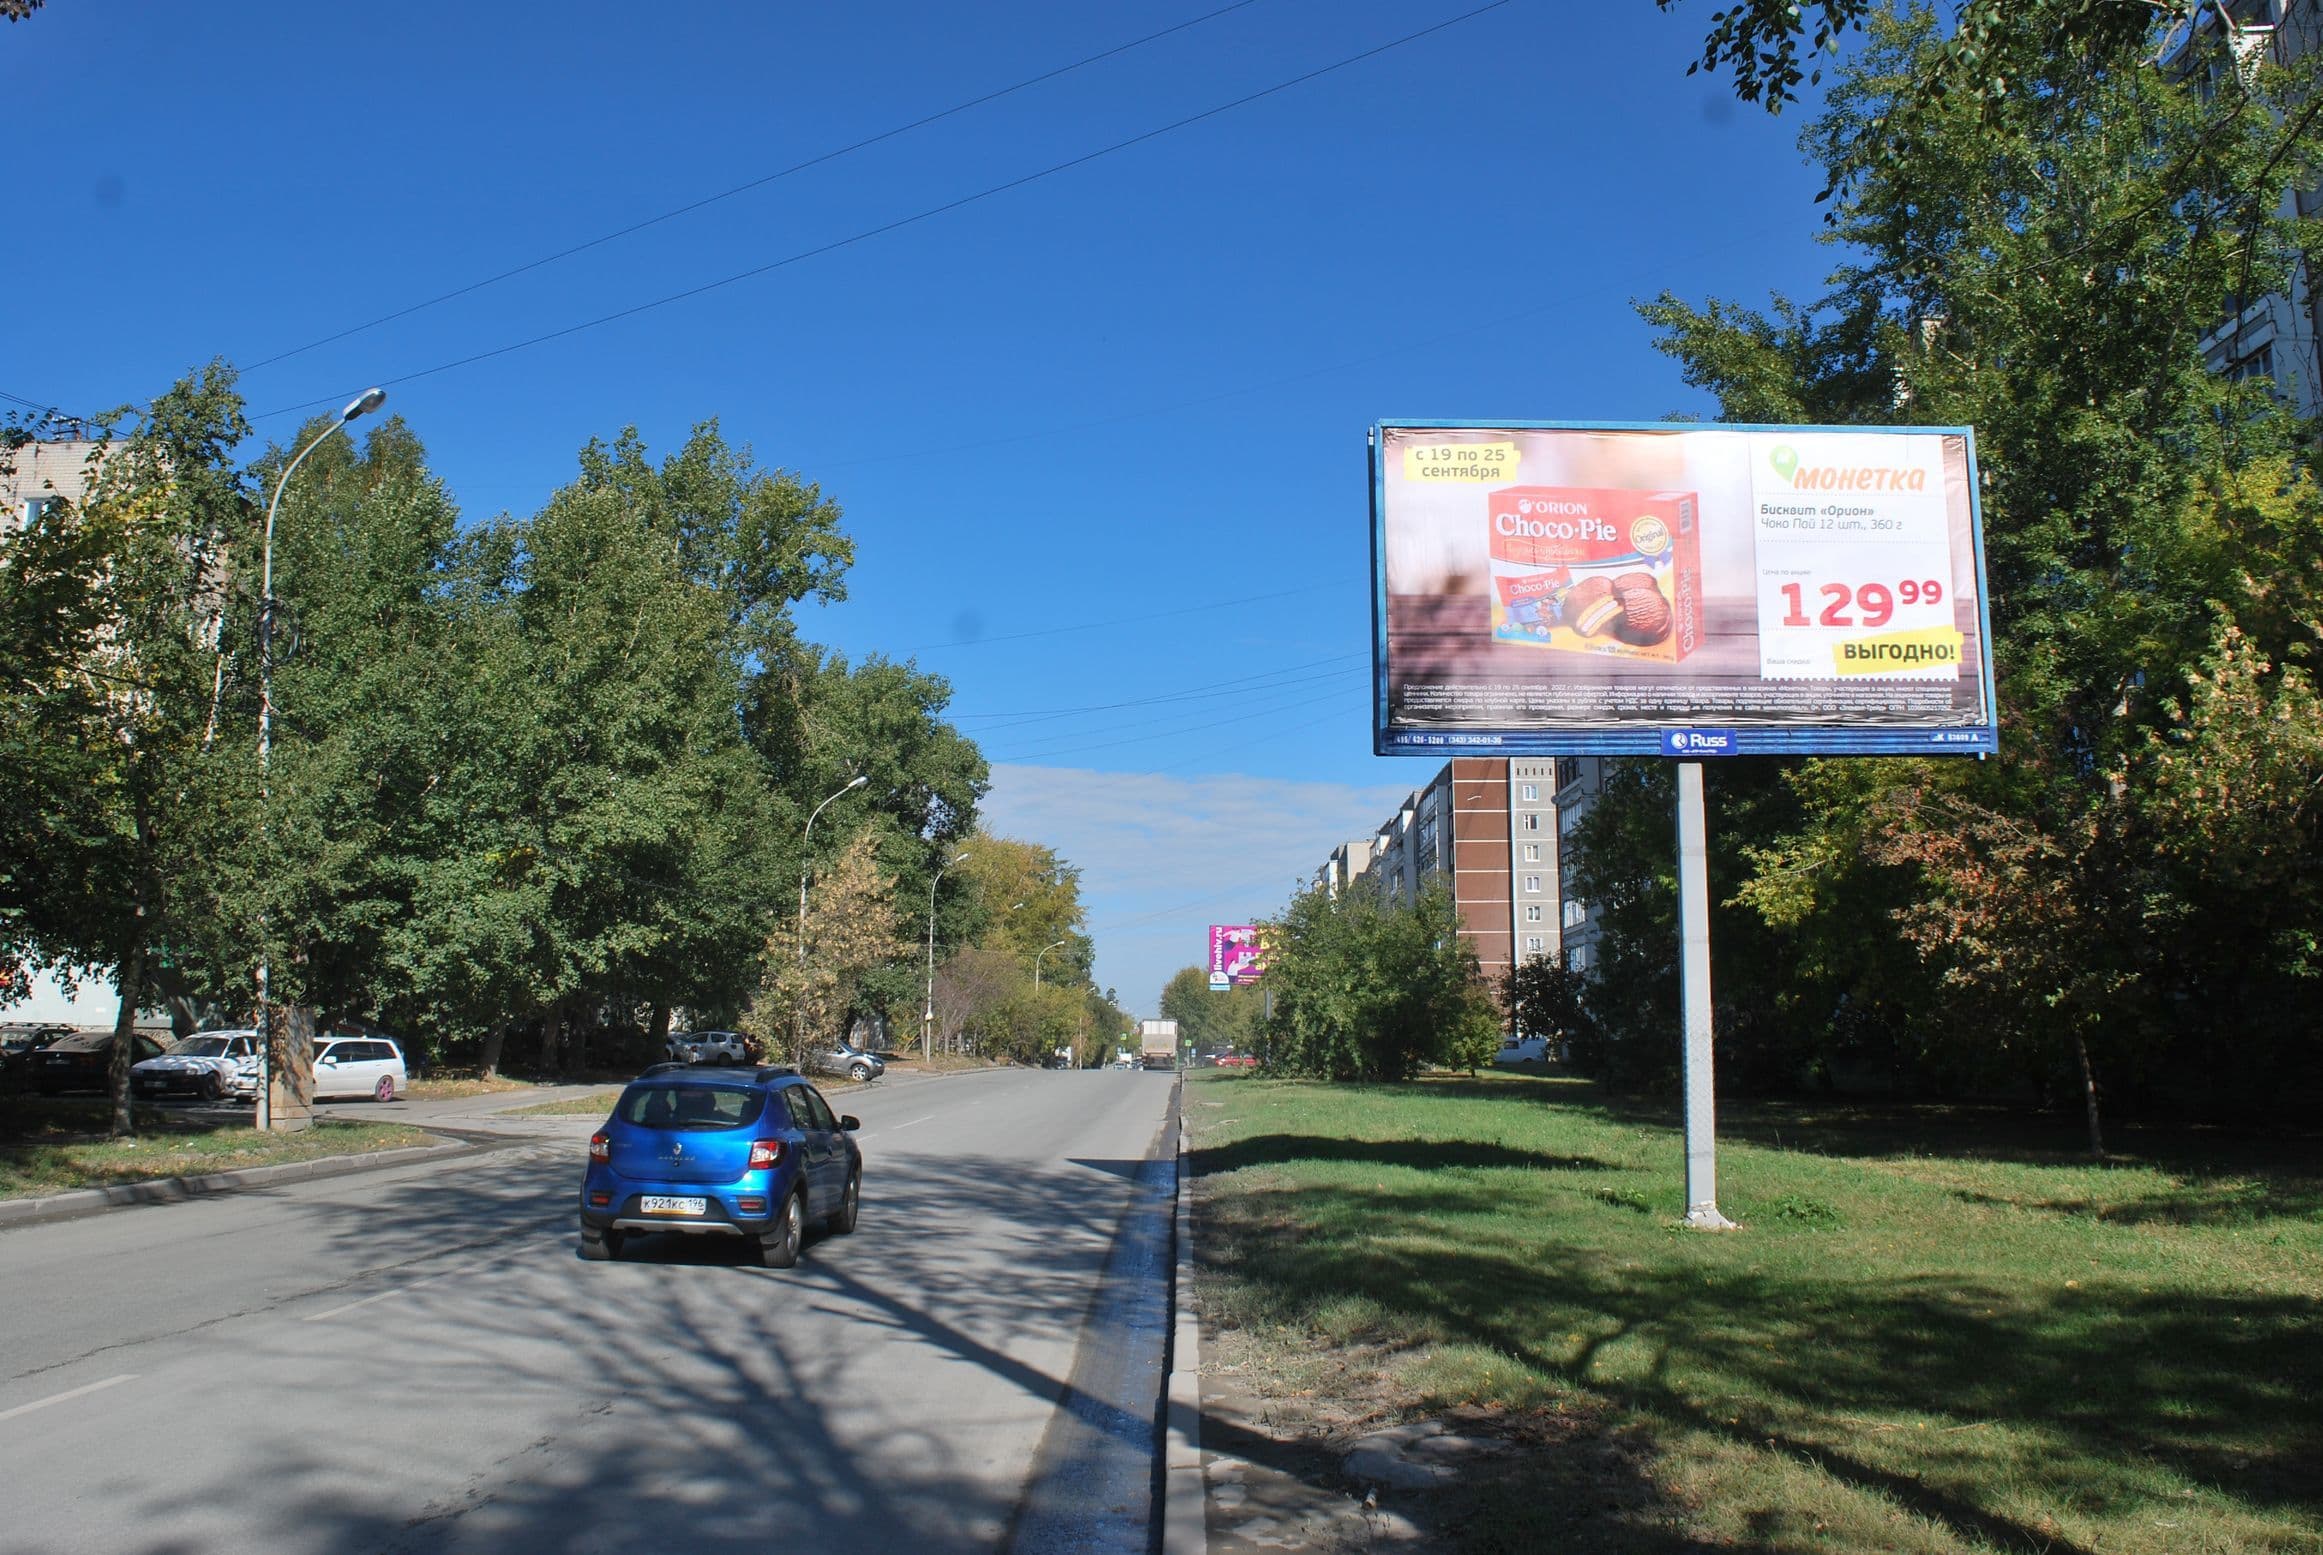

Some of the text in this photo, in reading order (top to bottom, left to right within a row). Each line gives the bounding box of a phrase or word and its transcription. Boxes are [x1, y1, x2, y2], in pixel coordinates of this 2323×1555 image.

[1415, 448, 1505, 461] с 19 по 25
[1421, 464, 1500, 480] сентября
[1536, 501, 1588, 515] ORION
[1760, 503, 1874, 518] Бисквит «Орион»
[1760, 517, 1790, 530] Чоко
[1820, 518, 1834, 530] 12
[1870, 519, 1894, 530] 360
[1844, 643, 1955, 663] ВЫГОДНО!
[1690, 733, 1728, 748] Russ
[1213, 926, 1223, 971] livehiv.ru
